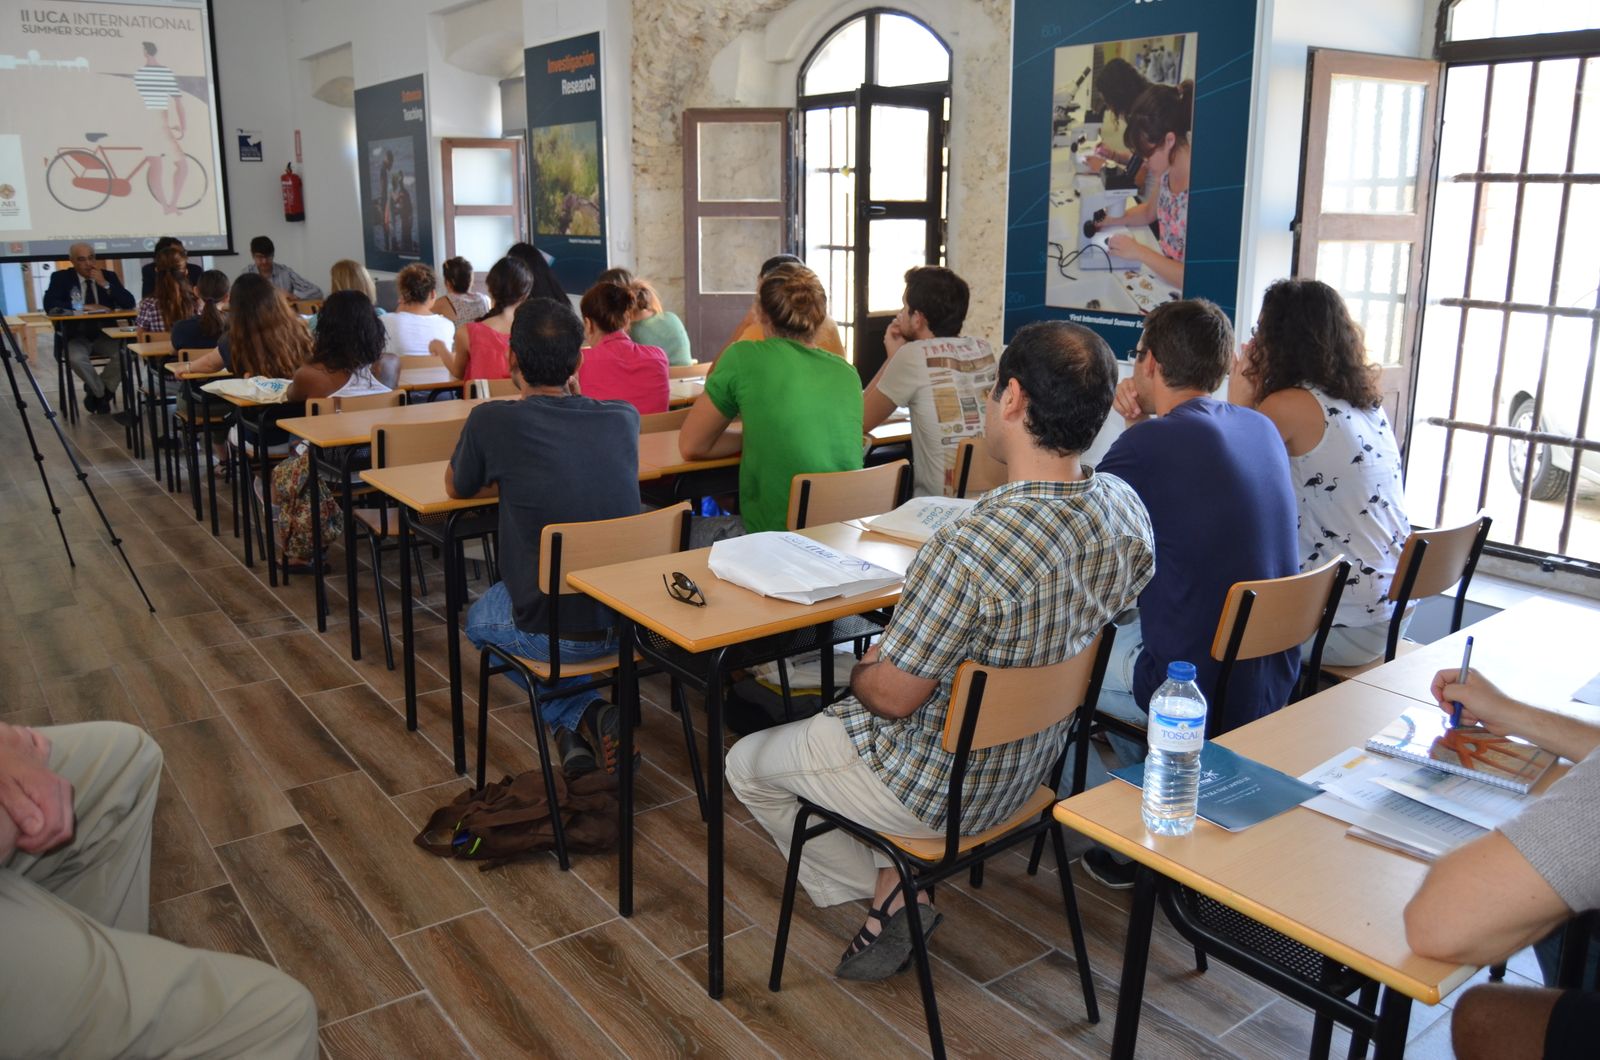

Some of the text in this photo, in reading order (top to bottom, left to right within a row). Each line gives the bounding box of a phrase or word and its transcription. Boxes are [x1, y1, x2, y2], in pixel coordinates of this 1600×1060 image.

[20, 9, 195, 32] II UCA INTERNATIONAL
[22, 24, 124, 38] SUMMER SCHOOL
[561, 74, 596, 95] Research
[1082, 315, 1114, 325] International
[1114, 318, 1136, 328] Summer
